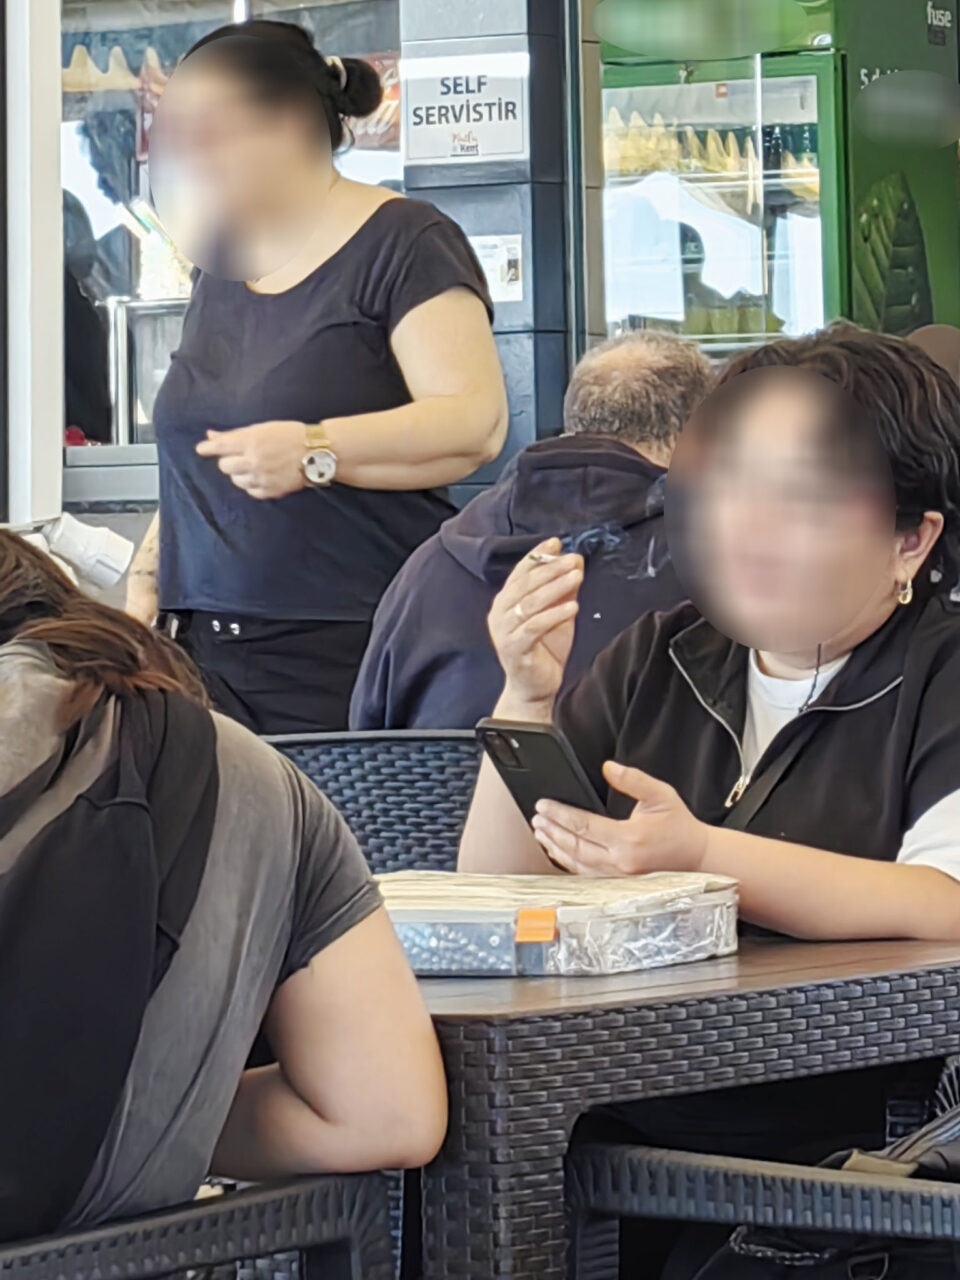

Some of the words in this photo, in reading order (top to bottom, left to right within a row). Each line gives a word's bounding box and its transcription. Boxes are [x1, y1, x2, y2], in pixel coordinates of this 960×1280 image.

[927, 0, 952, 27] fuse
[440, 75, 487, 95] SELF
[412, 97, 517, 126] SERVİSTİR
